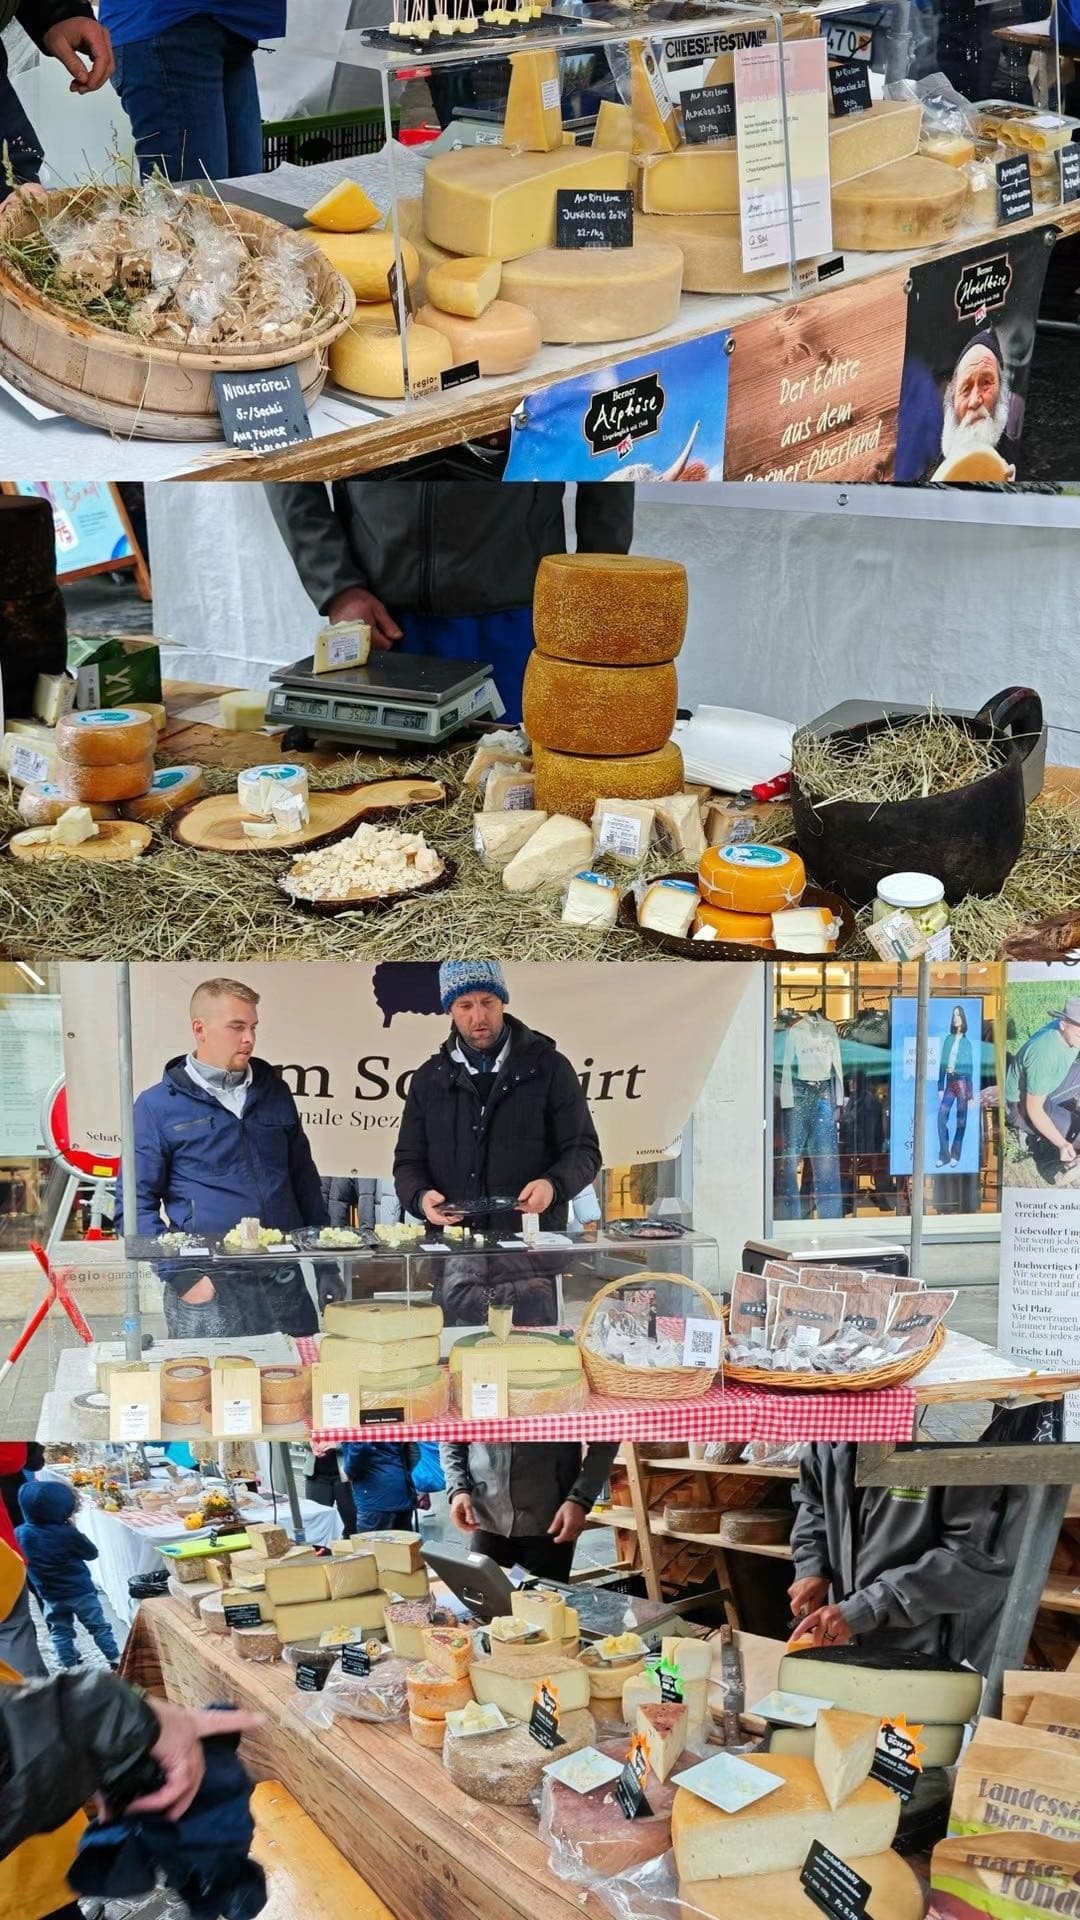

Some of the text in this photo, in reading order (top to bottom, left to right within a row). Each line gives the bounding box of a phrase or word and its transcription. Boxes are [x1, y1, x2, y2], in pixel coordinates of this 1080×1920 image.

[780, 358, 861, 404] Der Echte
[612, 388, 636, 402] Berner
[780, 402, 852, 448] aus dem
[807, 420, 883, 479] Oberland
[272, 1064, 334, 1099] m
[299, 1108, 400, 1131] nale Spez
[1015, 1201, 1047, 1210] Worauf
[1014, 1226, 1062, 1236] Liebevoller
[1014, 1261, 1073, 1271] Hochwertiges
[1012, 1304, 1052, 1314] Viel Platz
[1011, 1346, 1063, 1357] Frische Luft
